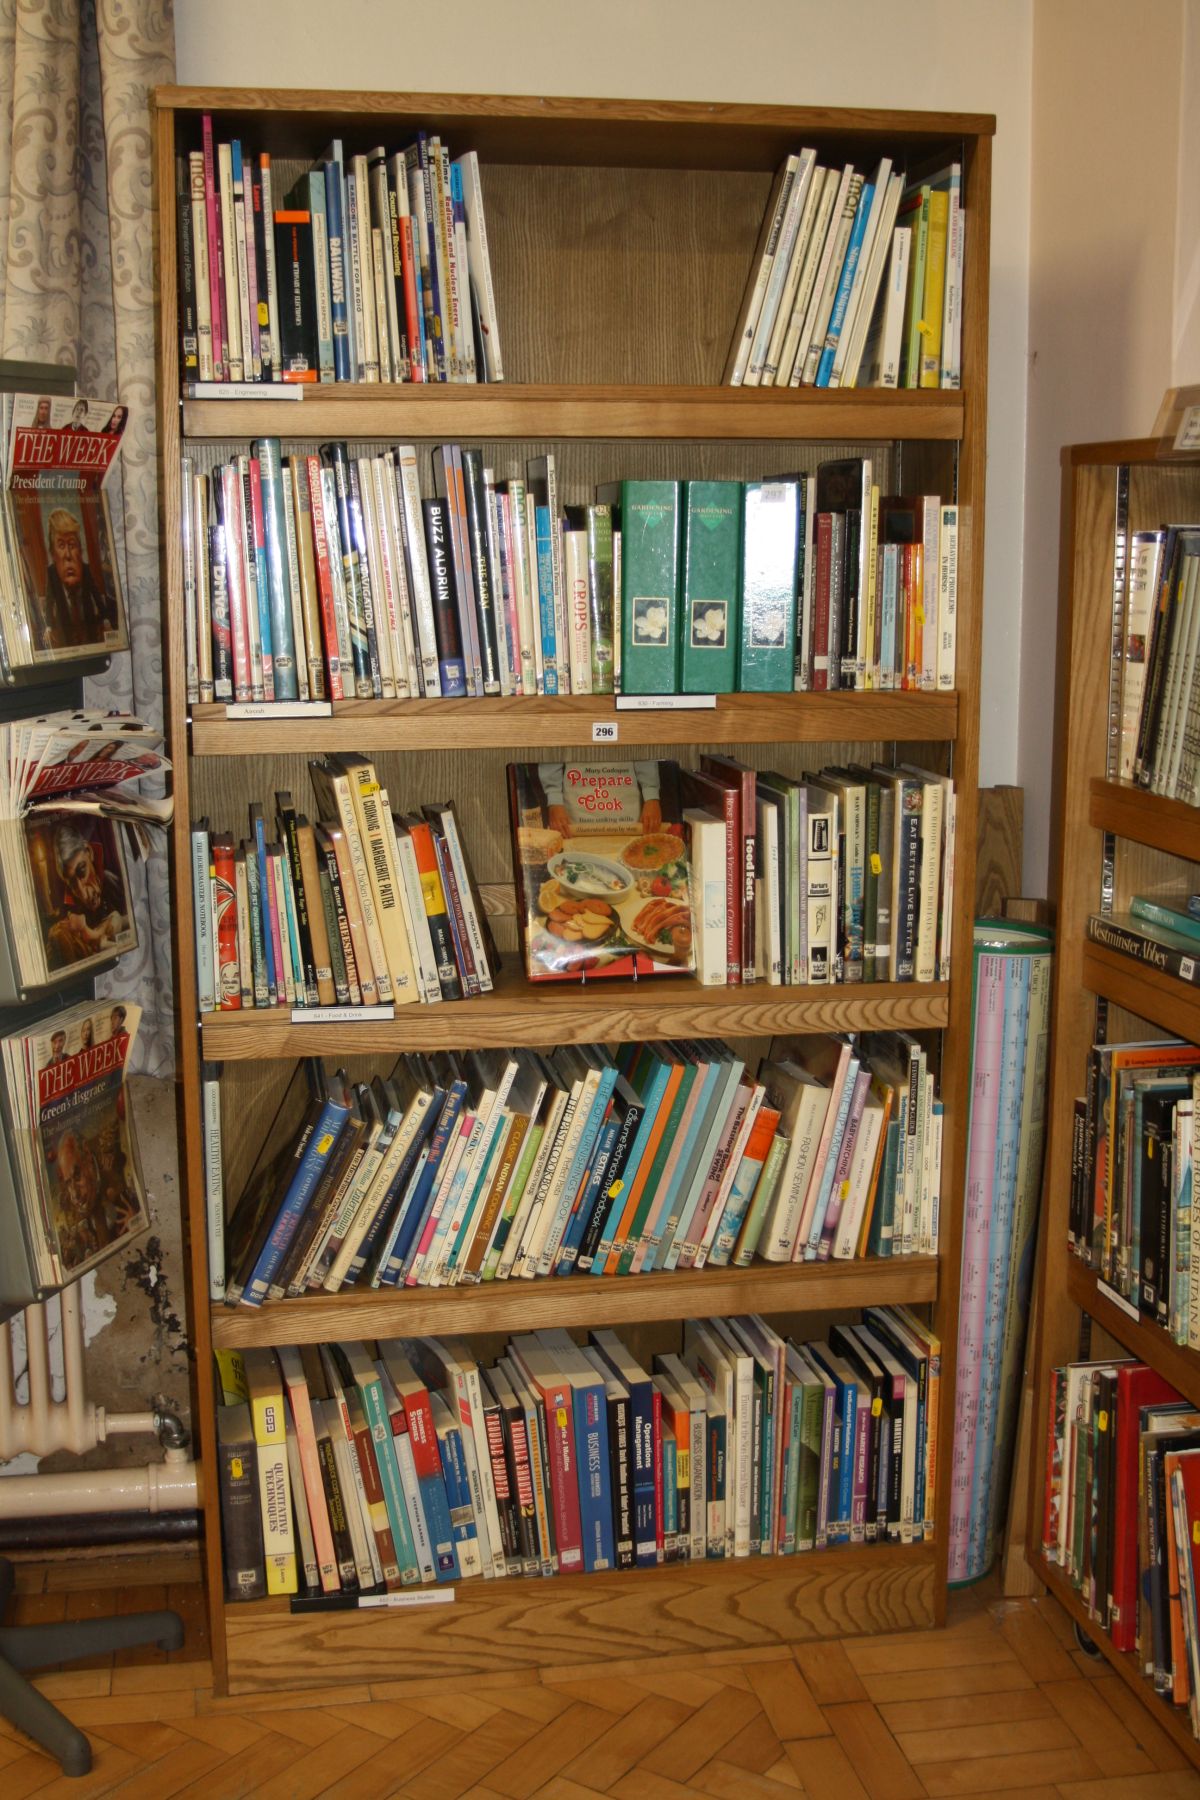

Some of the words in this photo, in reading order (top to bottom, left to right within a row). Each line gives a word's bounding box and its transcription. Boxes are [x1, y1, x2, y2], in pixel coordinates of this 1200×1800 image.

[191, 159, 206, 200] man
[348, 185, 357, 230] MARCONI'S
[841, 178, 862, 219] man
[445, 196, 454, 238] Radiation
[329, 238, 343, 303] RAILWAYS
[392, 236, 402, 276] Recording
[449, 262, 458, 298] Nuclear
[842, 271, 852, 289] and
[451, 302, 460, 327] Energy
[18, 433, 57, 463] THE
[59, 435, 117, 465] WEEK
[12, 475, 55, 489] President
[57, 475, 87, 493] Trump
[309, 460, 321, 508] CONQUEST
[317, 541, 326, 558] AIR
[431, 507, 444, 543] BUZZ
[435, 548, 449, 600] ALDRIN
[360, 563, 373, 629] NAVIGATION
[573, 579, 587, 631] CROPS
[596, 725, 614, 738] 296
[567, 769, 633, 789] Prepare
[594, 788, 609, 799] to
[367, 800, 380, 831] COOKING
[578, 796, 624, 812] Cook
[370, 839, 389, 882] MARGUERITE
[379, 884, 395, 909] PATTEN
[746, 872, 755, 901] Facts
[1090, 919, 1140, 954] Westminster
[1142, 941, 1168, 970] Abbey
[40, 1060, 74, 1098] THE
[78, 1036, 126, 1080] WEEK
[41, 1103, 71, 1122] Green's
[72, 1082, 106, 1106] disgrace
[598, 1082, 611, 1100] THE
[590, 1102, 604, 1127] SOFT
[736, 1106, 745, 1120] The
[209, 1129, 219, 1164] HEALTHY
[555, 1121, 573, 1150] PASTA
[725, 1120, 740, 1153] Batsford
[839, 1118, 858, 1175] BABYWATCHING
[568, 1129, 596, 1192] FURNISHINGS
[592, 1151, 609, 1186] TEXTILES
[708, 1149, 724, 1181] SEWING
[718, 1154, 730, 1173] Book
[795, 1137, 811, 1170] FASHION
[211, 1167, 220, 1195] EATING
[495, 1162, 510, 1192] INDIAN
[536, 1150, 563, 1204] COOKBOOK
[788, 1172, 803, 1204] SEWING
[335, 1188, 368, 1236] Entertaining
[559, 1194, 574, 1222] BOOK
[701, 1191, 713, 1213] Ladbury
[1190, 1255, 1200, 1324] BRITAIN
[486, 1414, 504, 1455] TROUBLE
[511, 1420, 530, 1462] TROUBLE
[587, 1432, 600, 1471] BUSINESS
[693, 1423, 703, 1455] BUSINESS
[493, 1457, 510, 1499] SHOOTER
[516, 1464, 533, 1505] SHOOTER
[265, 1468, 278, 1532] TECHNIQUES
[273, 1462, 288, 1535] QUANTITATIVE
[521, 1504, 535, 1518] 2
